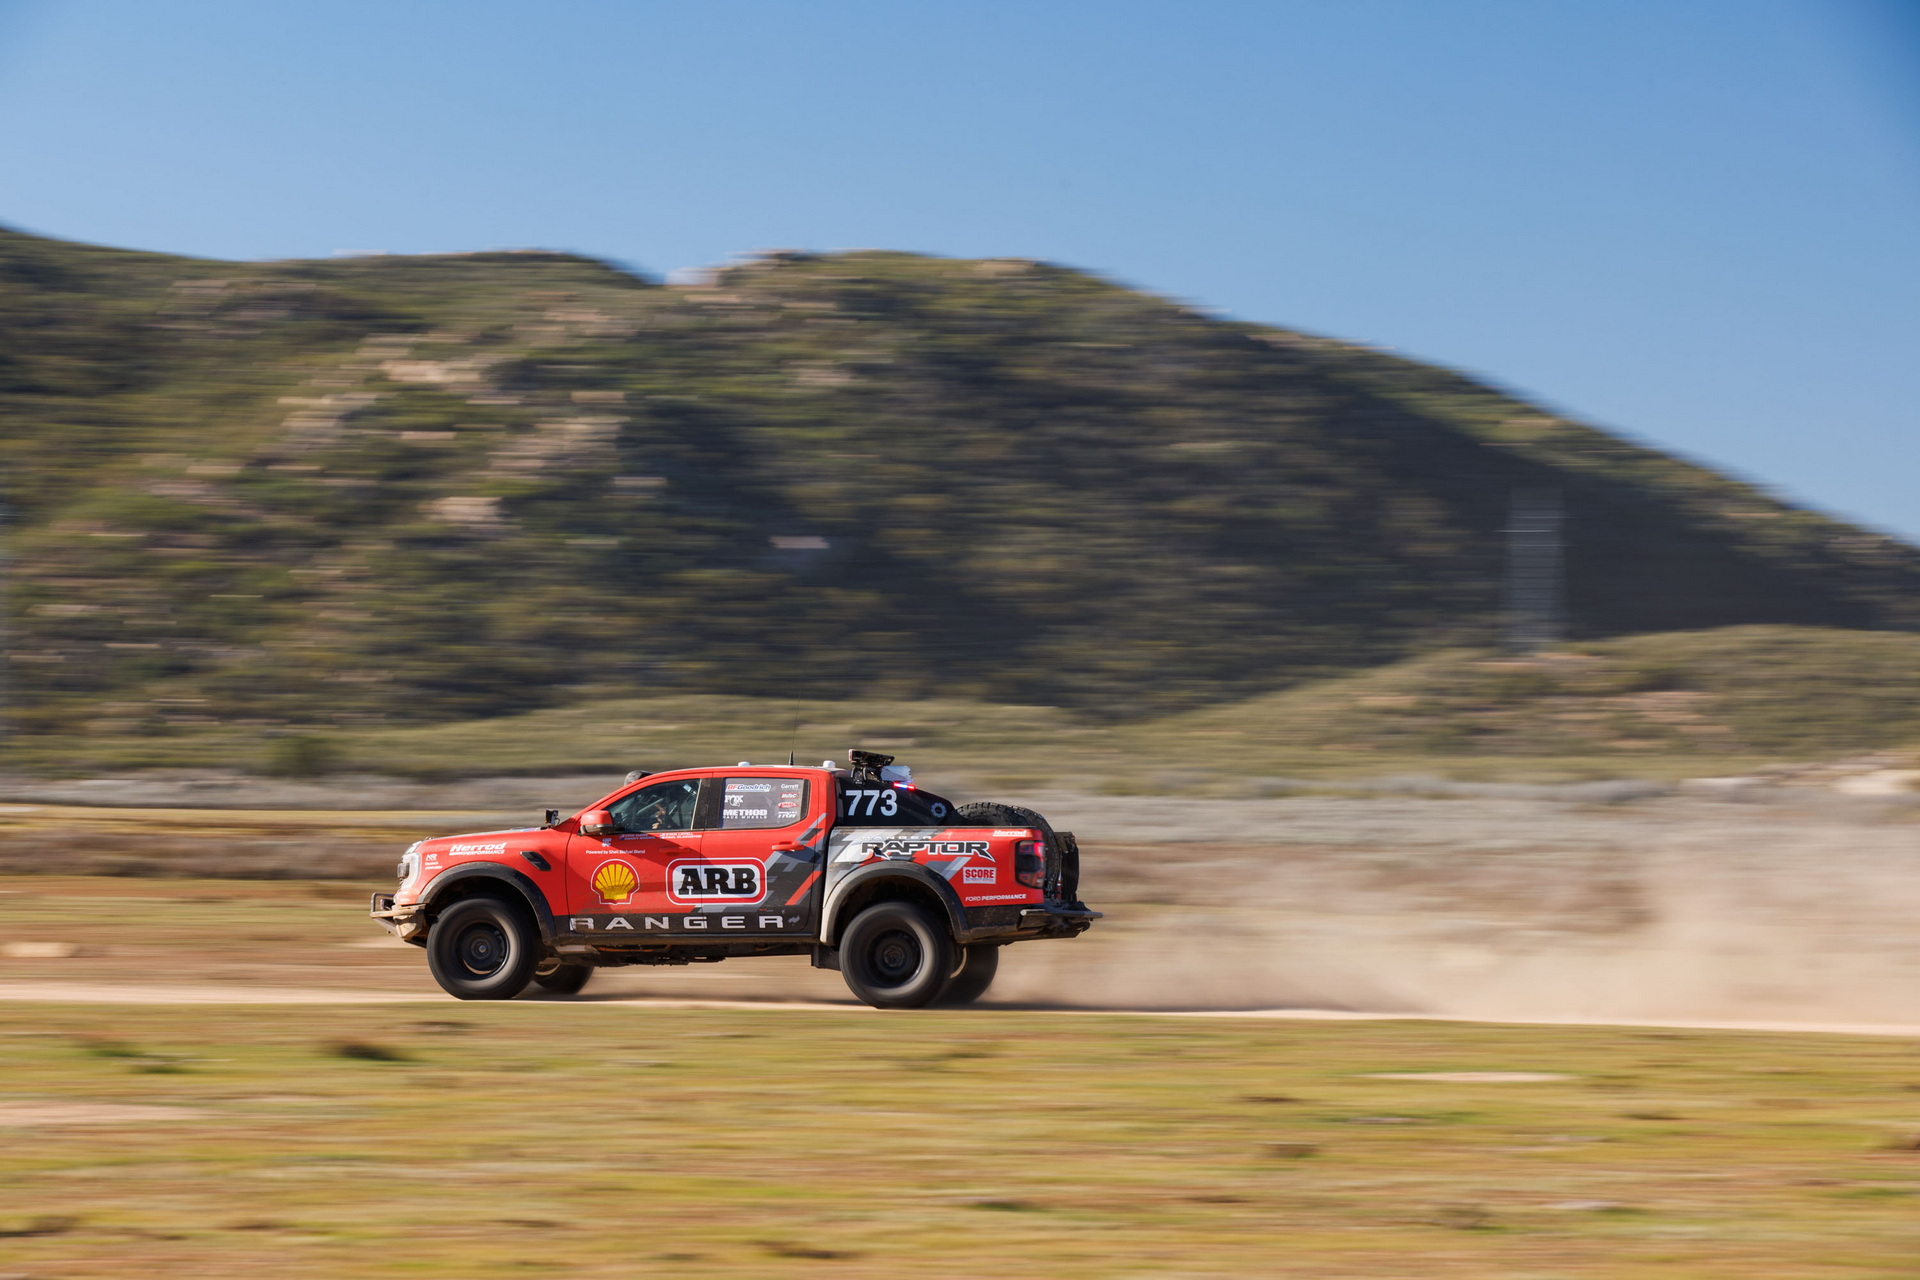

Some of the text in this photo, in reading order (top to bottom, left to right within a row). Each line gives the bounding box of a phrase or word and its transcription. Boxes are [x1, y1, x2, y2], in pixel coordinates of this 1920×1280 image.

[725, 794, 744, 806] FOX
[845, 789, 898, 817] 773
[992, 829, 1027, 837] Herrod
[450, 842, 507, 852] Herrod
[861, 841, 996, 863] RAPTOR
[964, 869, 995, 879] SCORE
[678, 868, 757, 895] ARB
[981, 893, 1027, 901] PERFORMANCE
[570, 915, 784, 931] RANGER
